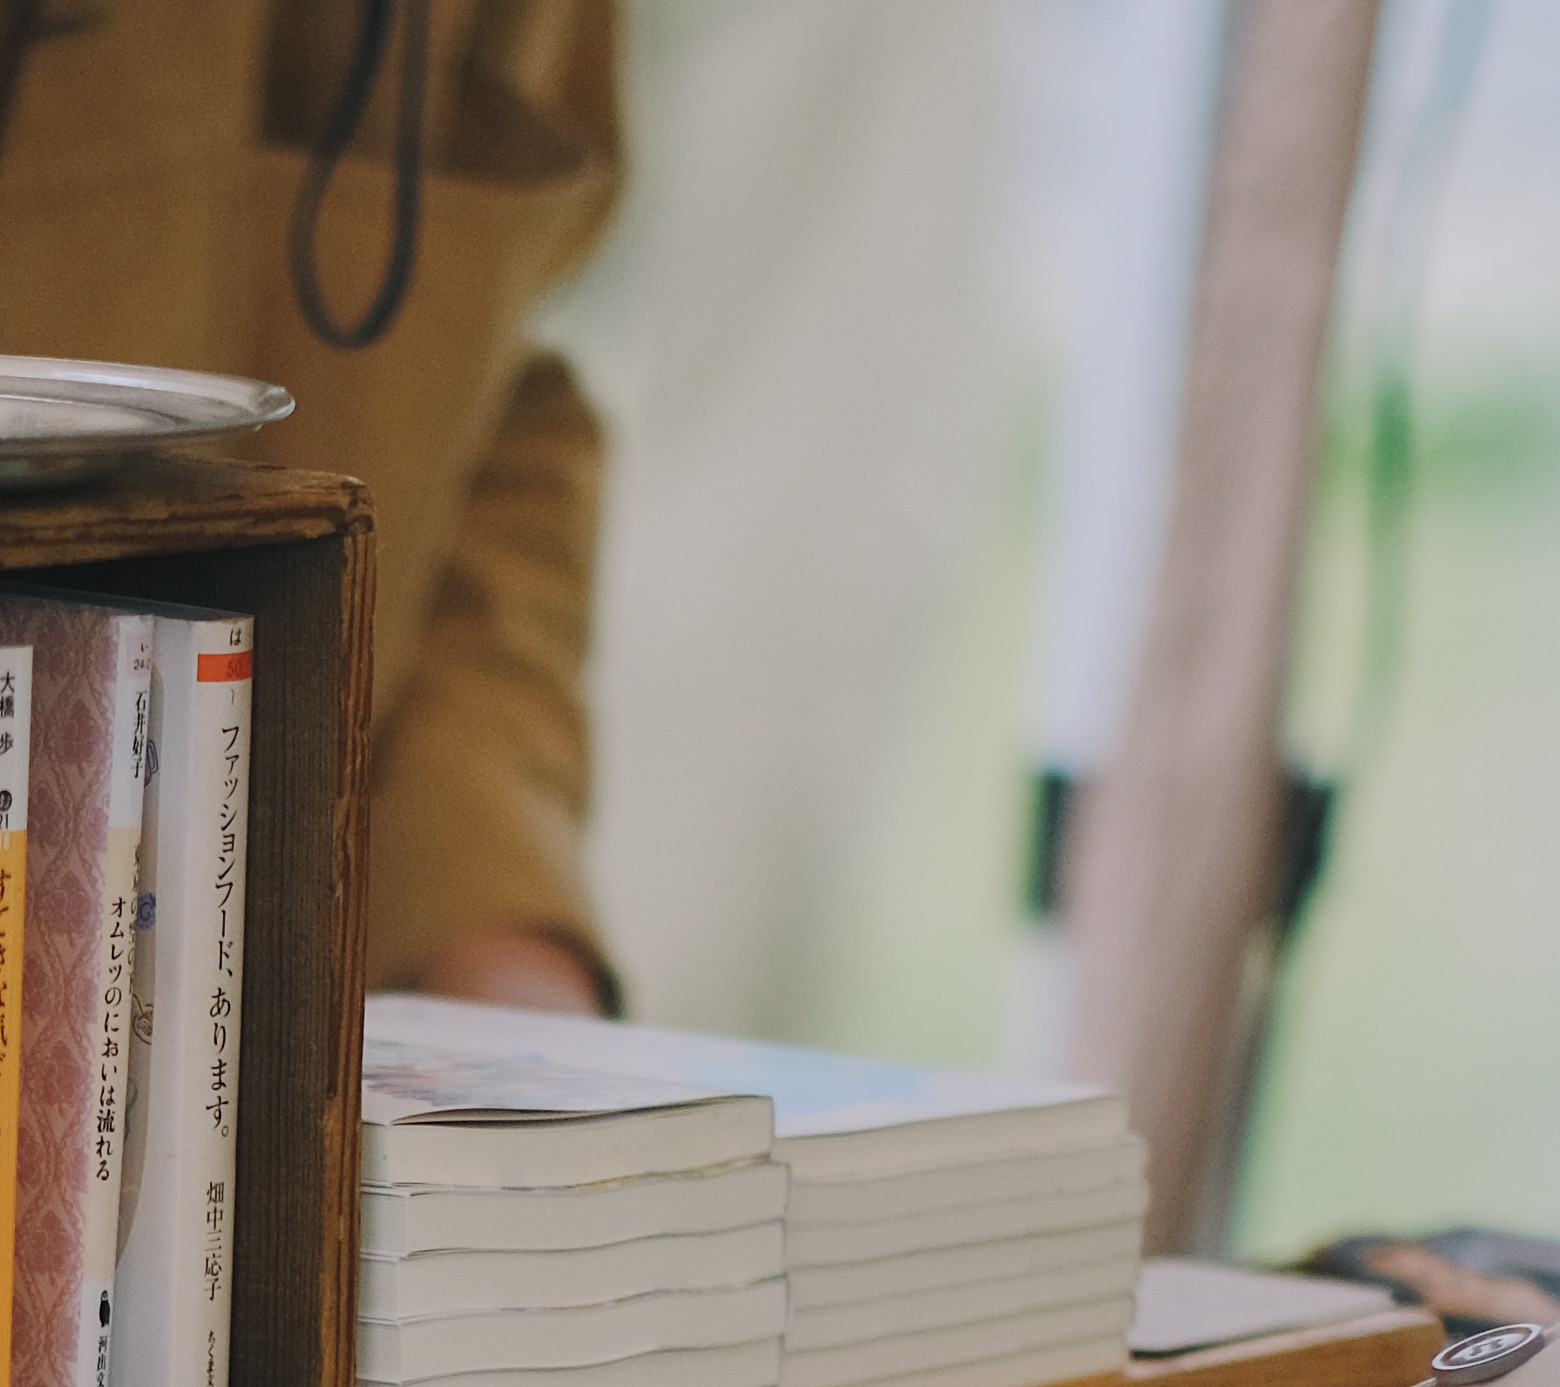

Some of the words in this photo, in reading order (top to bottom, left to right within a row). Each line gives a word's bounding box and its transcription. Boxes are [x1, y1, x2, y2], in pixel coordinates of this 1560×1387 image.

[131, 690, 148, 779] 石井好子
[206, 726, 240, 1139] ファッションフード、あります。
[94, 896, 128, 1181] オムレツのにおいは流れる
[203, 1180, 226, 1302] 畑中三応子
